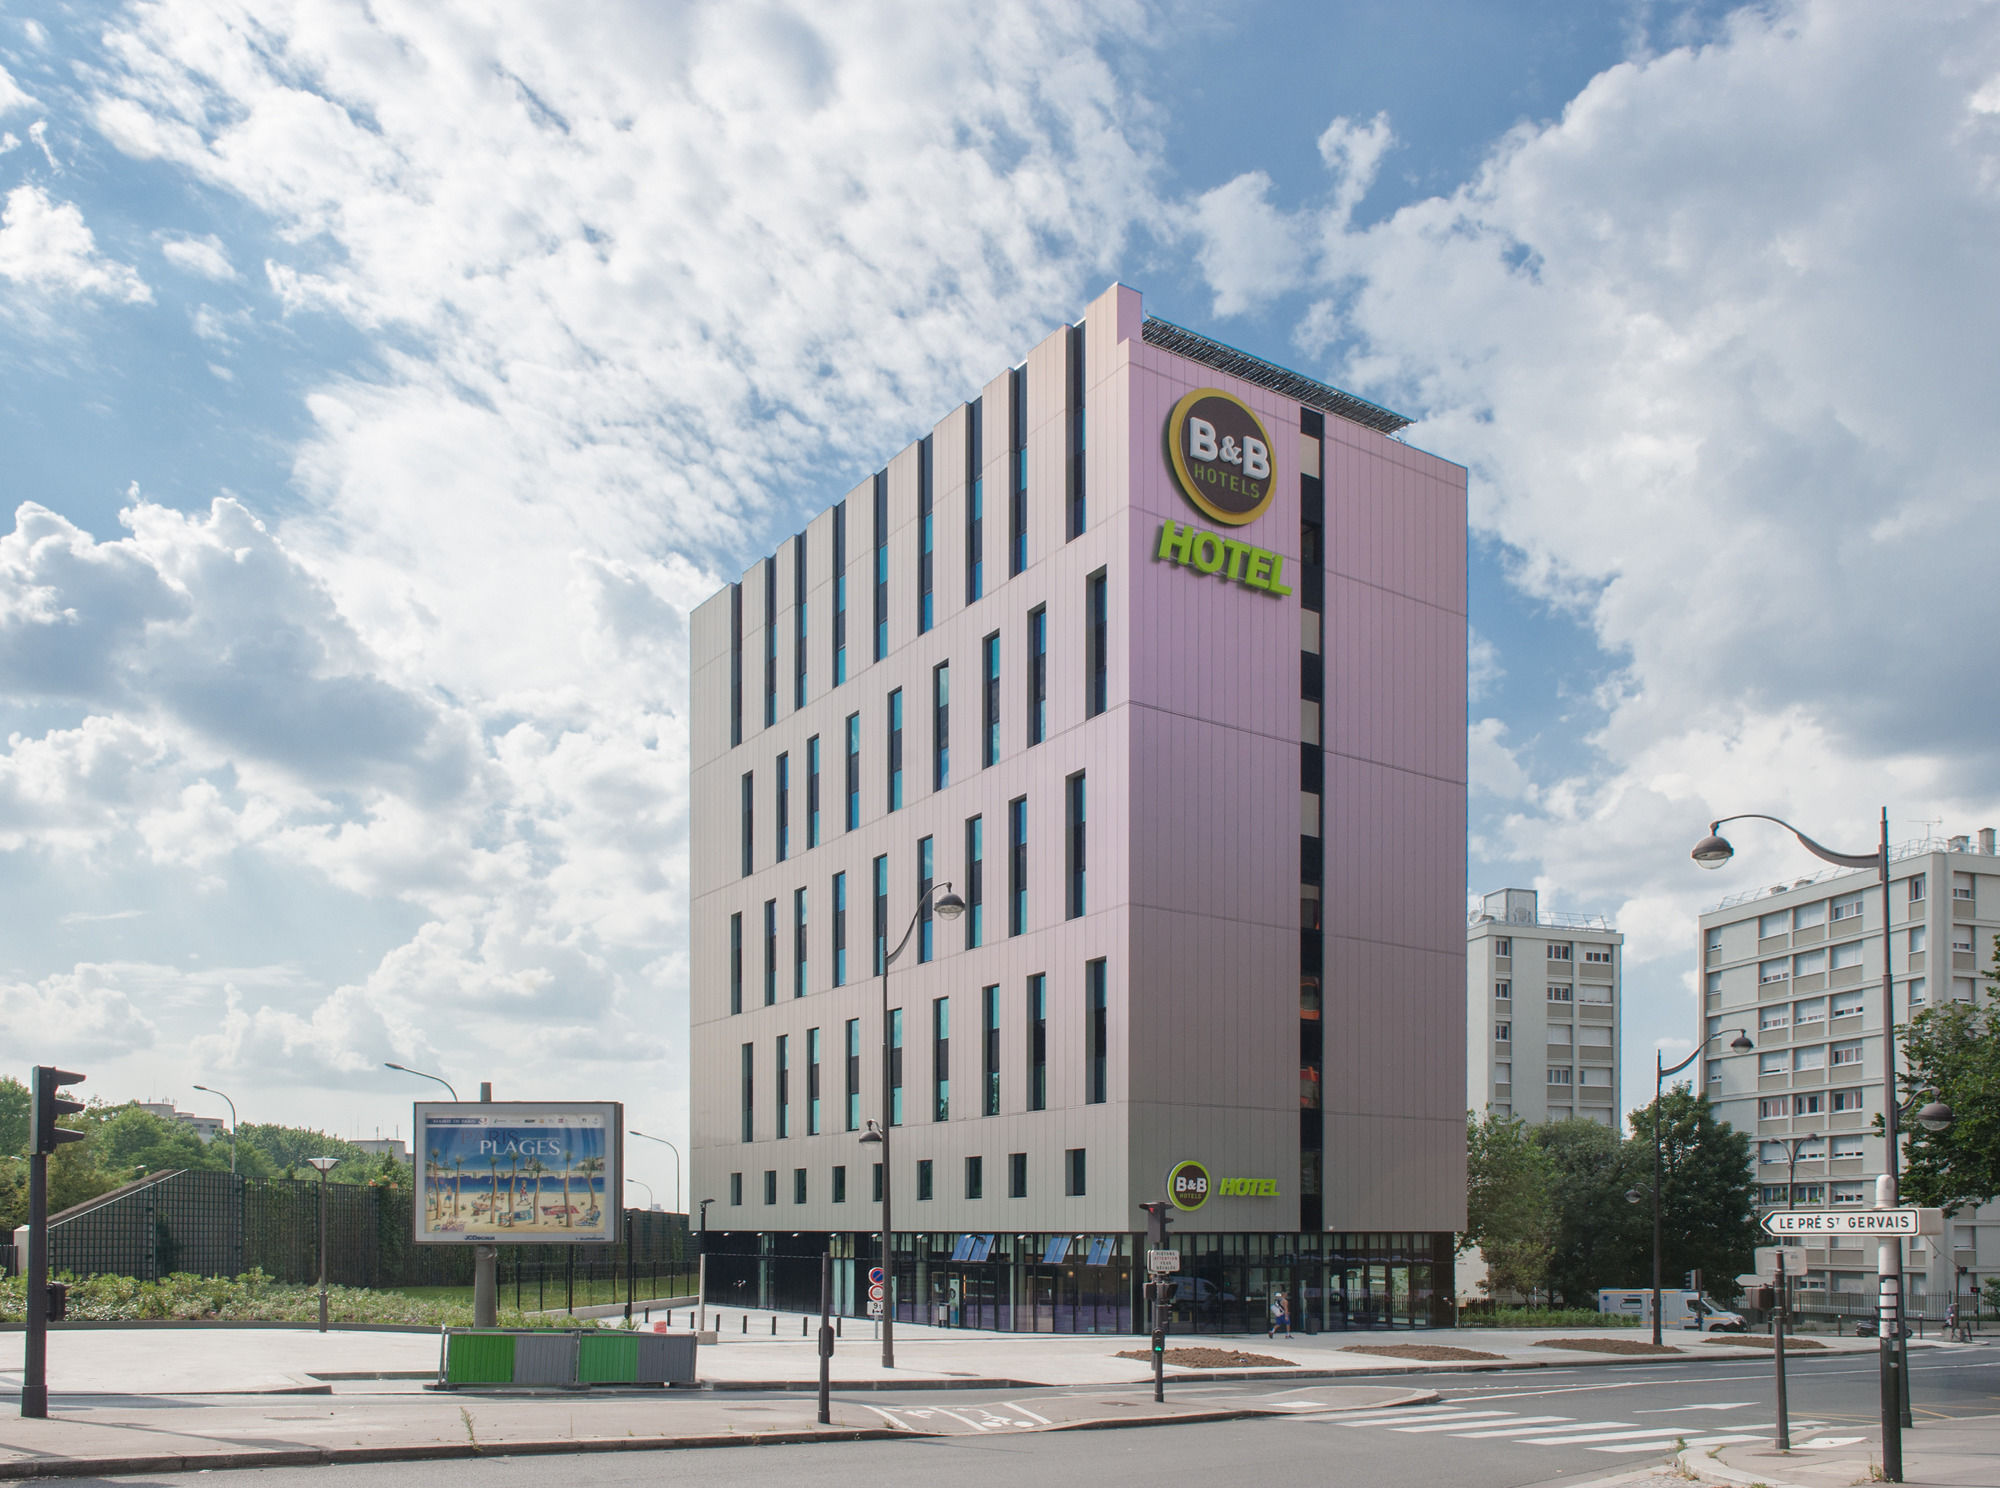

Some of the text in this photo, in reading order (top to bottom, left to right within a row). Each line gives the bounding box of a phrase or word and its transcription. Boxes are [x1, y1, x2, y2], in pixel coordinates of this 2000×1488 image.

[1189, 416, 1270, 480] B&B
[1193, 463, 1261, 499] HOTELS
[1158, 519, 1293, 596] HOTEL
[461, 1129, 519, 1145] PARIS
[480, 1140, 561, 1155] PLAGES
[1175, 1176, 1207, 1193] B&B
[1219, 1177, 1280, 1196] HOTEL
[1779, 1218, 1793, 1229] LE
[1798, 1215, 1821, 1228] PRÉ
[1848, 1216, 1909, 1228] GERVAIS
